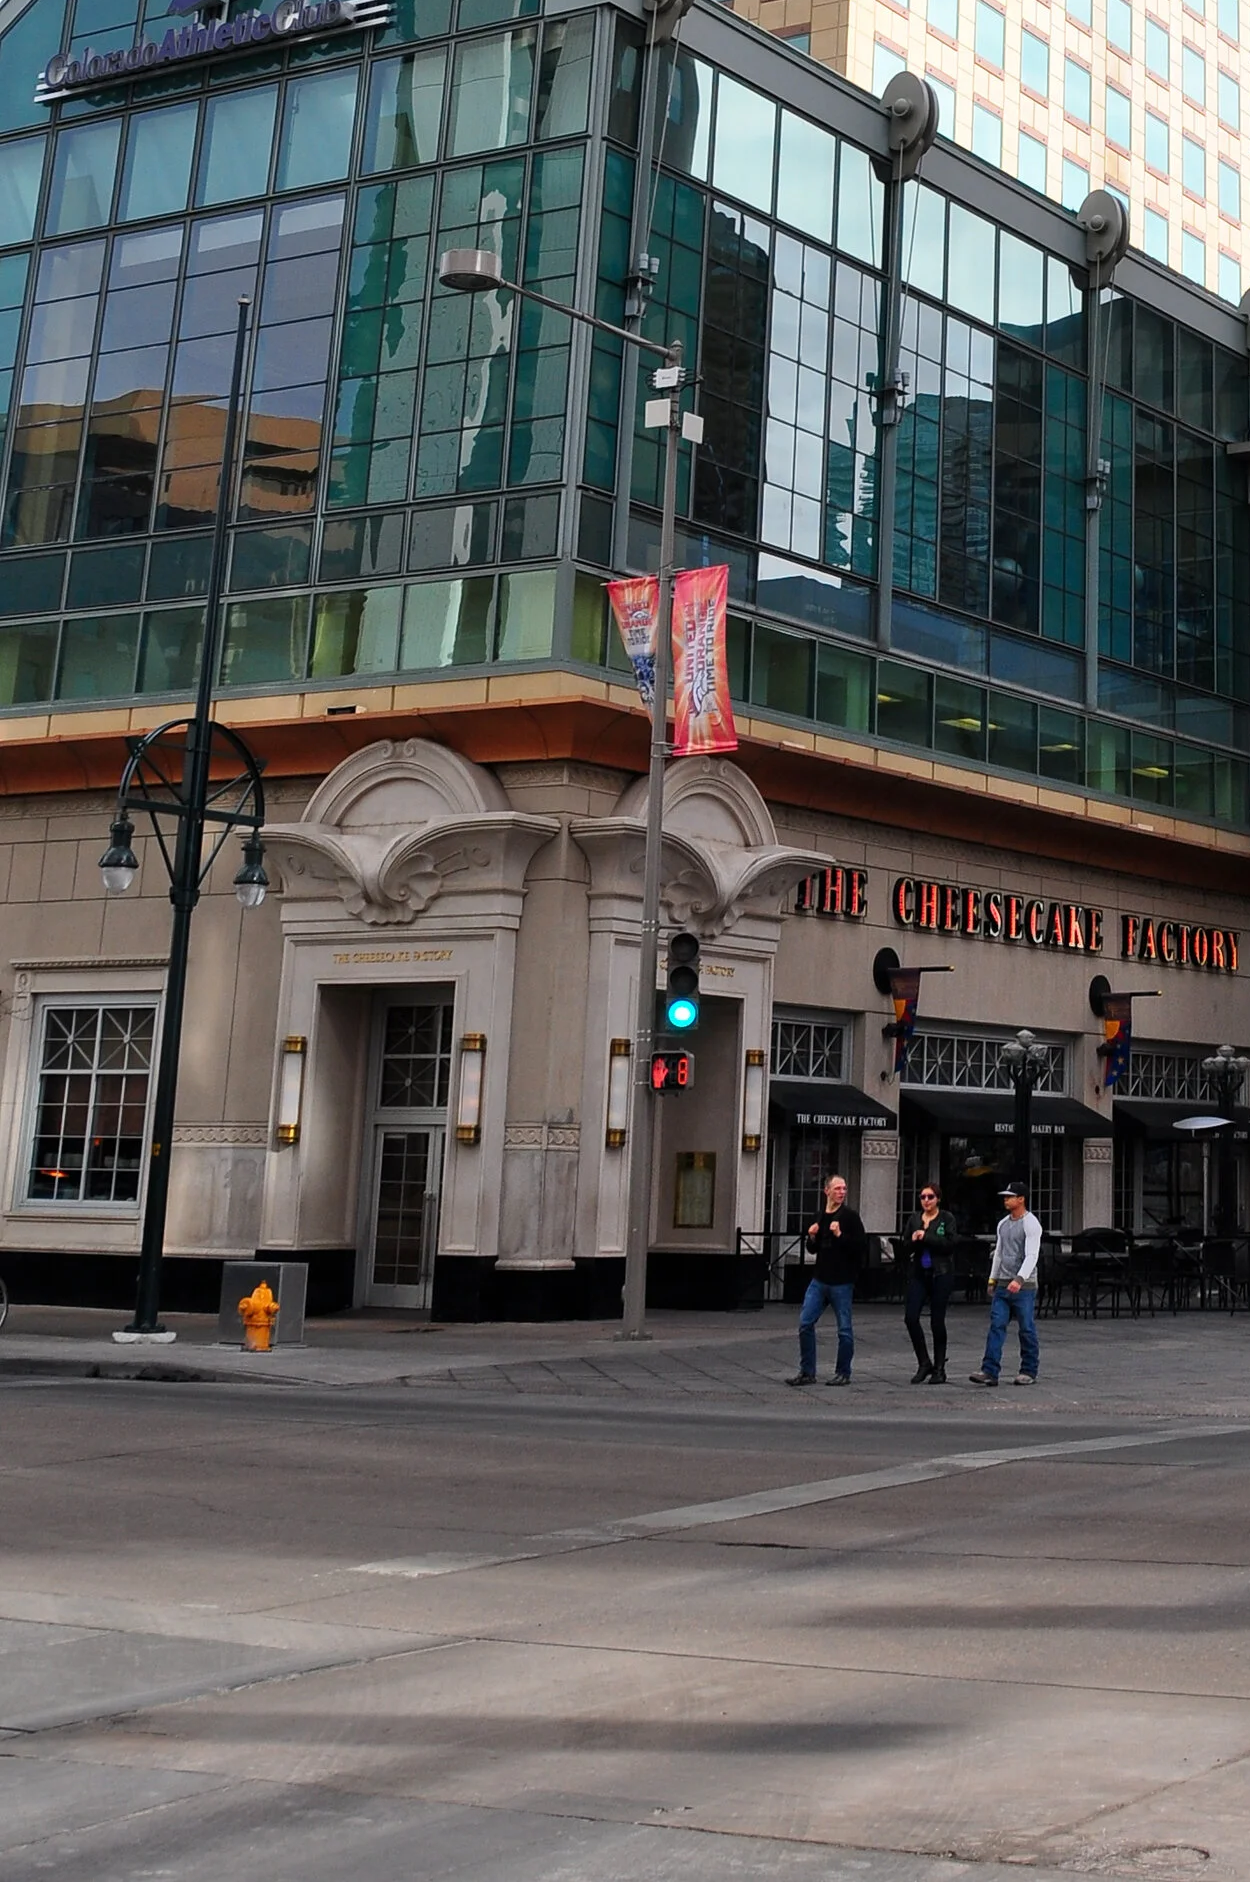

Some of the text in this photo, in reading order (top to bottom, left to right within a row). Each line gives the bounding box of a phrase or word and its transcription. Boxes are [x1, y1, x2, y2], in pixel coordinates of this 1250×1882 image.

[685, 620, 696, 684] UNITED
[706, 599, 716, 693] TIME TO RIDE
[795, 867, 1240, 972] THE CHEESECAKE FACTORY
[796, 1113, 888, 1127] THE CHEESECAKE FACTORY
